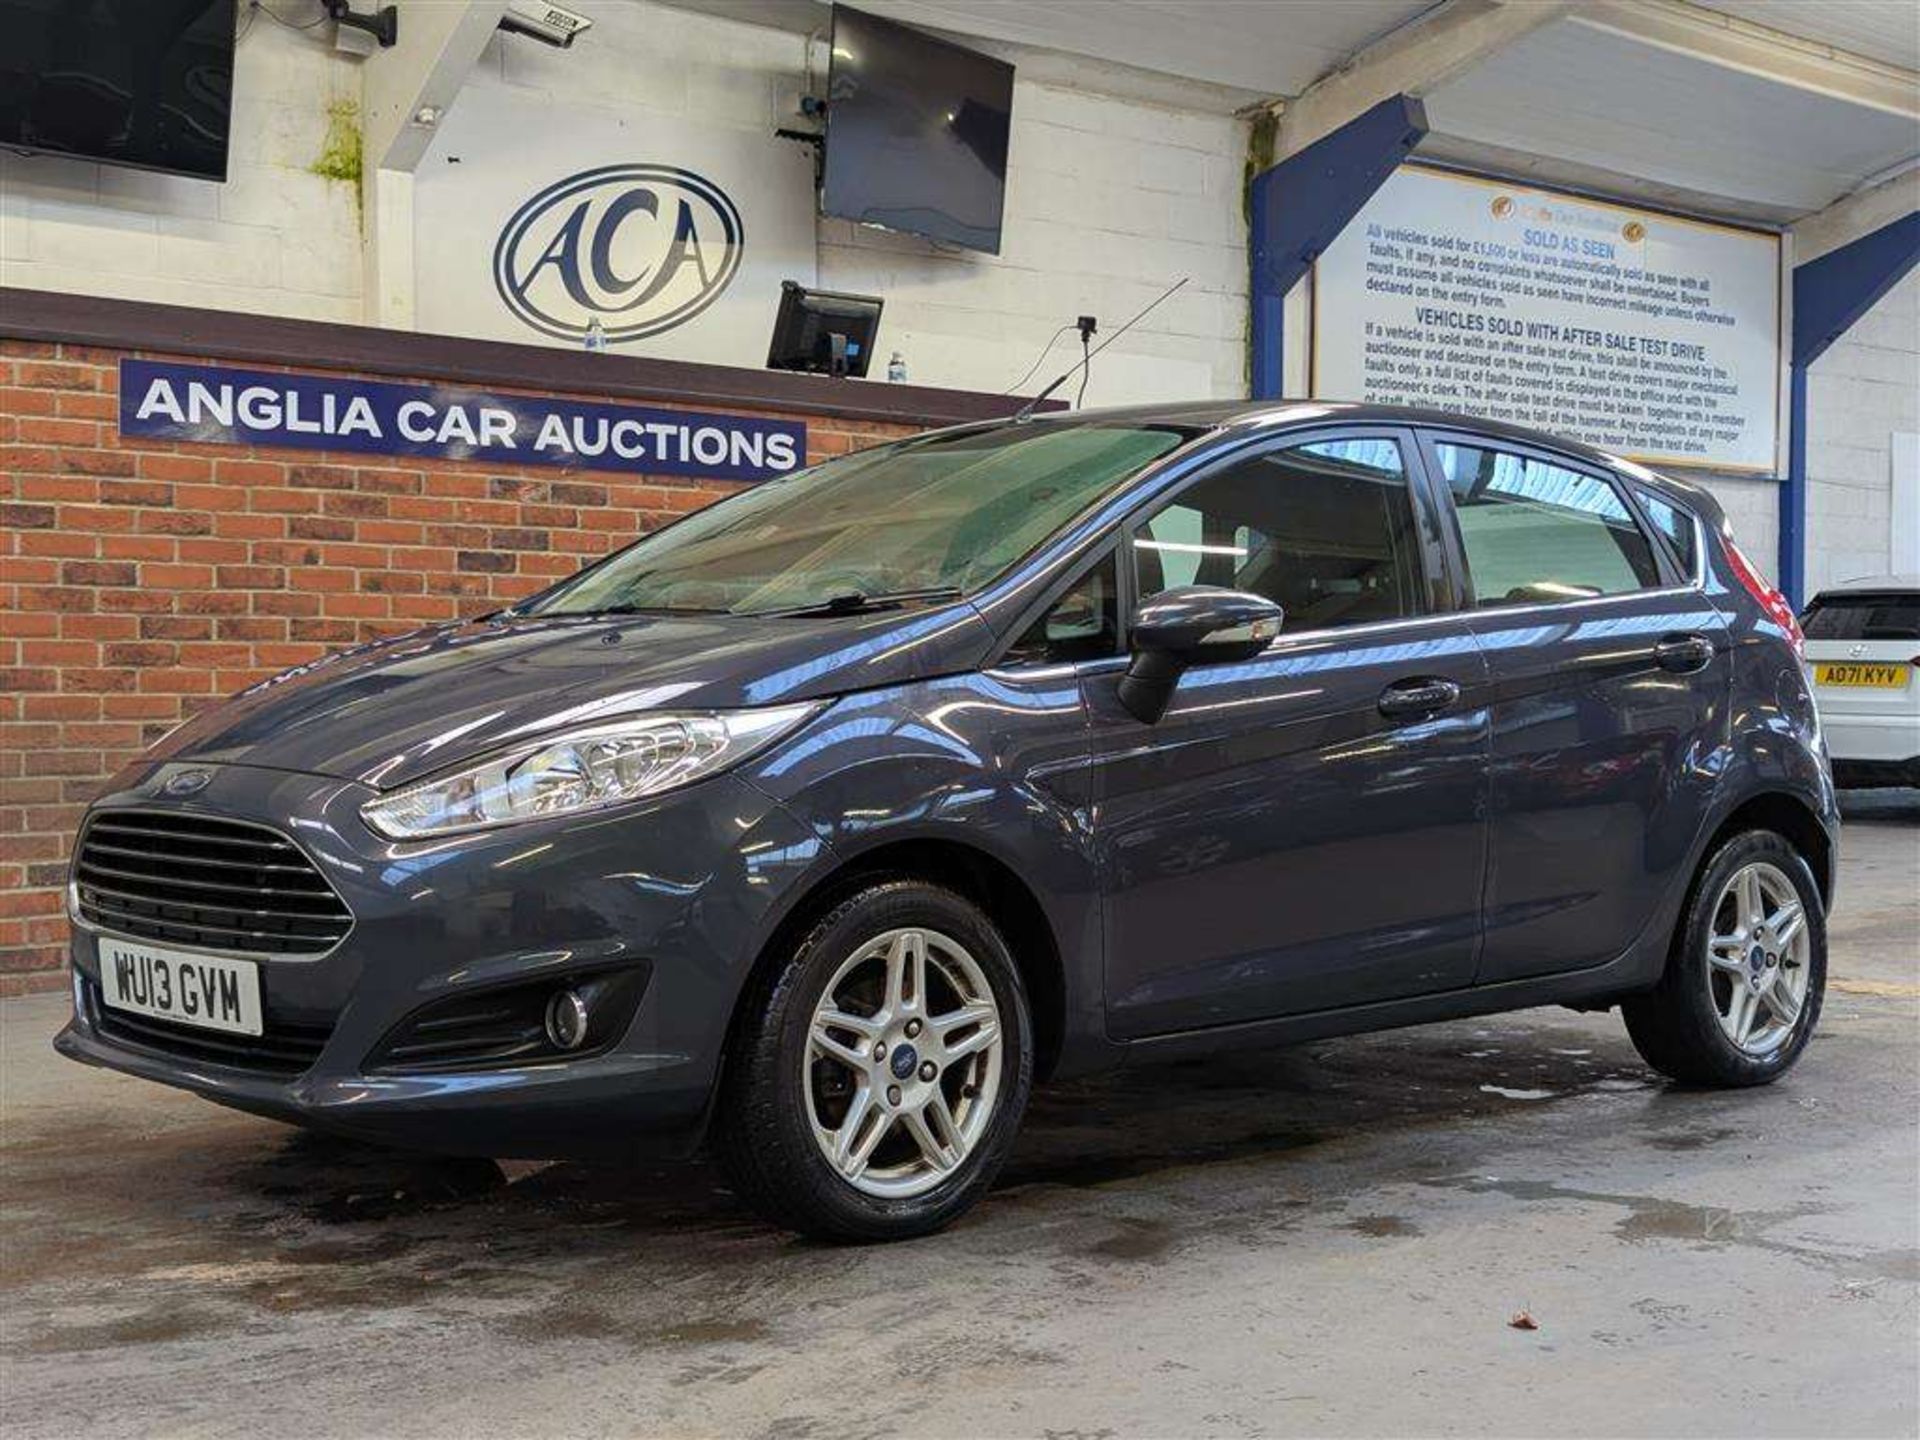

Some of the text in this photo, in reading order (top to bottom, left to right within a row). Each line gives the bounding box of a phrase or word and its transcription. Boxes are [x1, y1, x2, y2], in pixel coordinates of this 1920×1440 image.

[515, 188, 712, 312] ACA
[1384, 229, 1427, 246] vehicles
[1431, 237, 1452, 250] sold
[1456, 239, 1470, 253] for
[1507, 250, 1519, 260] or
[1521, 249, 1539, 264] less
[1543, 256, 1558, 266] are
[1623, 267, 1641, 279] sold
[1645, 272, 1654, 281] as
[1657, 274, 1676, 285] seen
[1680, 275, 1696, 288] with
[1700, 278, 1709, 290] all
[1524, 229, 1614, 258] SOLD AS SEEN
[1366, 263, 1393, 275] must
[1396, 267, 1438, 282] assume
[1441, 272, 1453, 284] all
[1455, 275, 1496, 290] vehicles
[1500, 282, 1520, 294] sold
[1523, 286, 1533, 296] as
[1537, 288, 1558, 299] seen
[1562, 289, 1583, 303] have
[1586, 293, 1625, 309] incorrect
[1629, 300, 1662, 317] mileage
[1665, 306, 1692, 318] unless
[1366, 277, 1412, 295] declared
[1415, 287, 1428, 297] on
[1432, 287, 1447, 300] the
[1451, 291, 1477, 307] entry
[1440, 255, 1458, 267] and
[1462, 260, 1473, 270] no
[1477, 262, 1530, 278] complaints
[1534, 269, 1586, 287] whatsoever
[1590, 277, 1609, 290] shall
[1613, 280, 1624, 292] be
[1681, 290, 1709, 307] Buyers
[1386, 326, 1422, 341] vehicle
[1426, 330, 1434, 342] is
[1438, 333, 1460, 345] sold
[1463, 336, 1484, 348] with
[1487, 340, 1498, 350] an
[1502, 340, 1522, 353] after
[1526, 344, 1545, 356] sale
[1549, 346, 1566, 358] test
[1597, 352, 1613, 364] this
[1616, 355, 1637, 367] shall
[1640, 357, 1649, 369] be
[1653, 361, 1698, 375] announced
[1702, 365, 1711, 381] by
[1714, 367, 1726, 378] the
[1416, 308, 1705, 360] VEHICLES SOLD WITH AFTER SALE TEST DRIVE
[1365, 341, 1420, 358] auctioneer
[1424, 348, 1443, 360] and
[1447, 349, 1490, 366] declared
[1493, 357, 1505, 368] on
[1509, 357, 1523, 370] the
[1525, 360, 1549, 377] entry
[1579, 364, 1585, 377] A
[1588, 366, 1605, 380] test
[1608, 369, 1630, 383] drive
[1633, 374, 1662, 386] covers
[1665, 378, 1688, 392] major
[1365, 357, 1394, 372] faults
[1435, 366, 1451, 379] full
[1454, 368, 1470, 381] list
[1472, 370, 1482, 382] of
[1485, 371, 1511, 385] faults
[1515, 377, 1552, 390] covered
[1554, 379, 1562, 391] is
[1565, 381, 1609, 399] displayed
[1613, 386, 1621, 398] in
[1623, 387, 1636, 399] the
[1640, 390, 1663, 402] office
[1666, 394, 1682, 405] and
[1685, 395, 1701, 407] with
[1704, 397, 1716, 408] the
[136, 378, 797, 470] ANGLIA CAR AUCTIONS
[1443, 403, 1461, 413] one
[1464, 403, 1487, 416] hour
[1491, 405, 1512, 418] from
[1515, 408, 1529, 420] the
[1533, 410, 1546, 422] fall
[1550, 412, 1558, 423] of
[1561, 413, 1575, 425] the
[1620, 419, 1636, 435] Any
[1639, 423, 1685, 437] complaints
[1689, 427, 1697, 437] of
[1699, 430, 1712, 442] any
[1715, 431, 1739, 444] major
[1464, 386, 1482, 399] The
[1485, 389, 1507, 401] after
[1510, 392, 1529, 404] sale
[1532, 393, 1550, 406] test
[1552, 396, 1575, 408] drive
[1578, 400, 1601, 411] must
[1603, 401, 1614, 413] be
[1647, 406, 1682, 421] together
[1685, 411, 1702, 422] with
[1712, 415, 1744, 427] member
[1584, 434, 1600, 442] one
[1603, 433, 1623, 445] hour
[1627, 436, 1646, 447] from
[1649, 438, 1663, 448] the
[1666, 440, 1681, 450] test
[114, 951, 241, 1023] WU13 GVM
